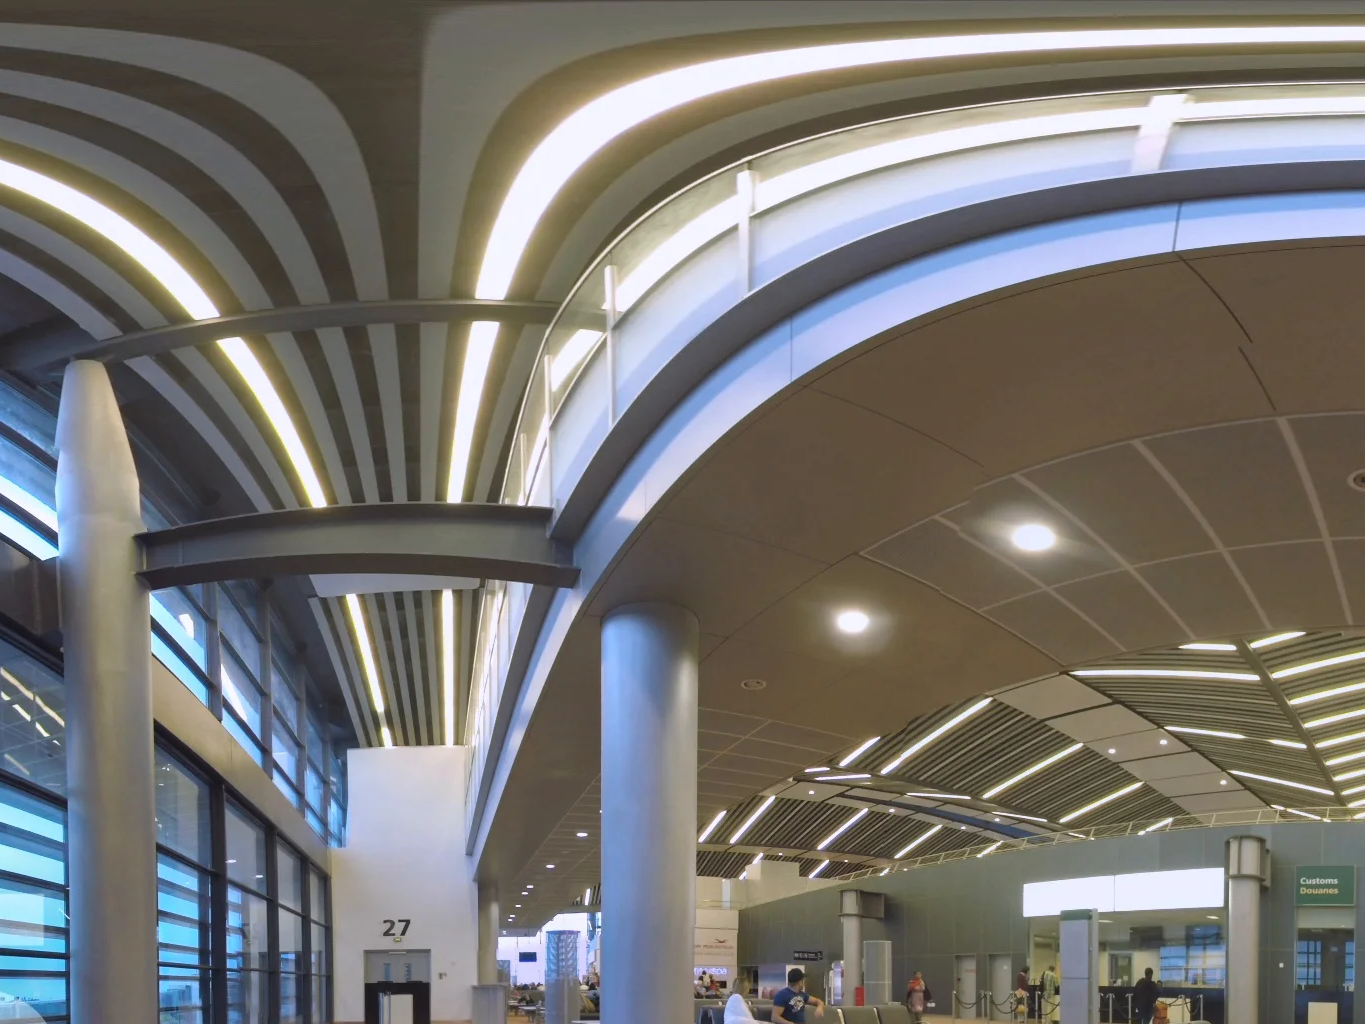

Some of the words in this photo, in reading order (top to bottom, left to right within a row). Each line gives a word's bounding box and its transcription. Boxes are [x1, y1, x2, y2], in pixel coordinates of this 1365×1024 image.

[1300, 877, 1339, 885] Customs
[1300, 887, 1339, 895] Douanes
[382, 919, 411, 937] 27
